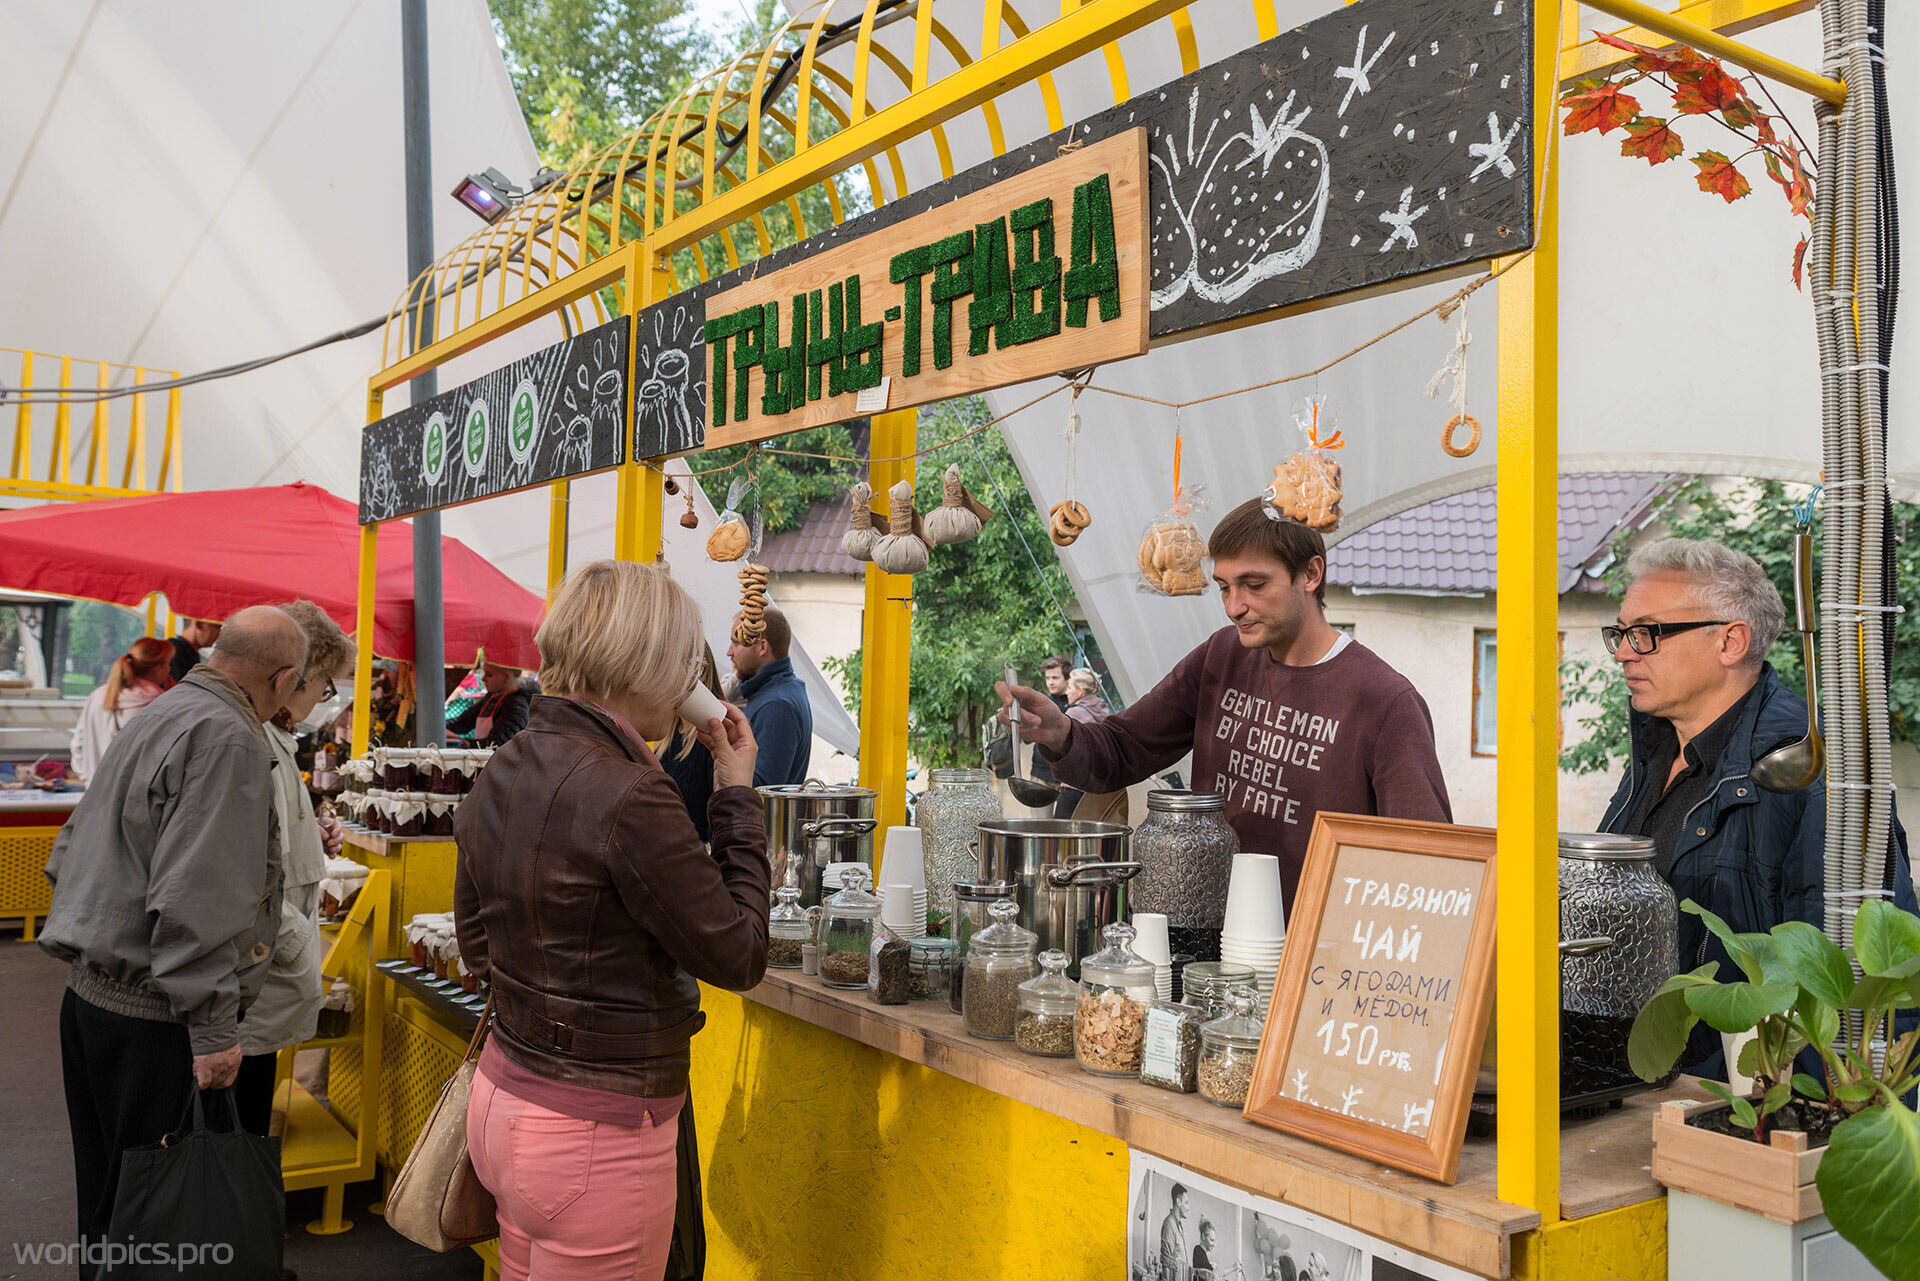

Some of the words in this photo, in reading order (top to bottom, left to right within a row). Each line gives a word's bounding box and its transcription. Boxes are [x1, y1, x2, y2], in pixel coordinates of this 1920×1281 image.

[704, 173, 1121, 427] ТРЫНЬ-ТРАВА
[1220, 688, 1340, 744] GENTLEMAN
[1216, 715, 1242, 743] BY
[1246, 726, 1325, 771] CHOICE
[1228, 749, 1288, 792] REBEL
[1215, 772, 1238, 801] BY
[1242, 785, 1301, 825] FATE
[1344, 877, 1473, 916] ТРАВЯНОЙ
[1352, 920, 1423, 963] ЧАЙ
[1311, 966, 1325, 985] С
[1337, 969, 1451, 1003] ЯГОДАМИ
[1321, 997, 1334, 1016] И
[1316, 1018, 1379, 1066] 150
